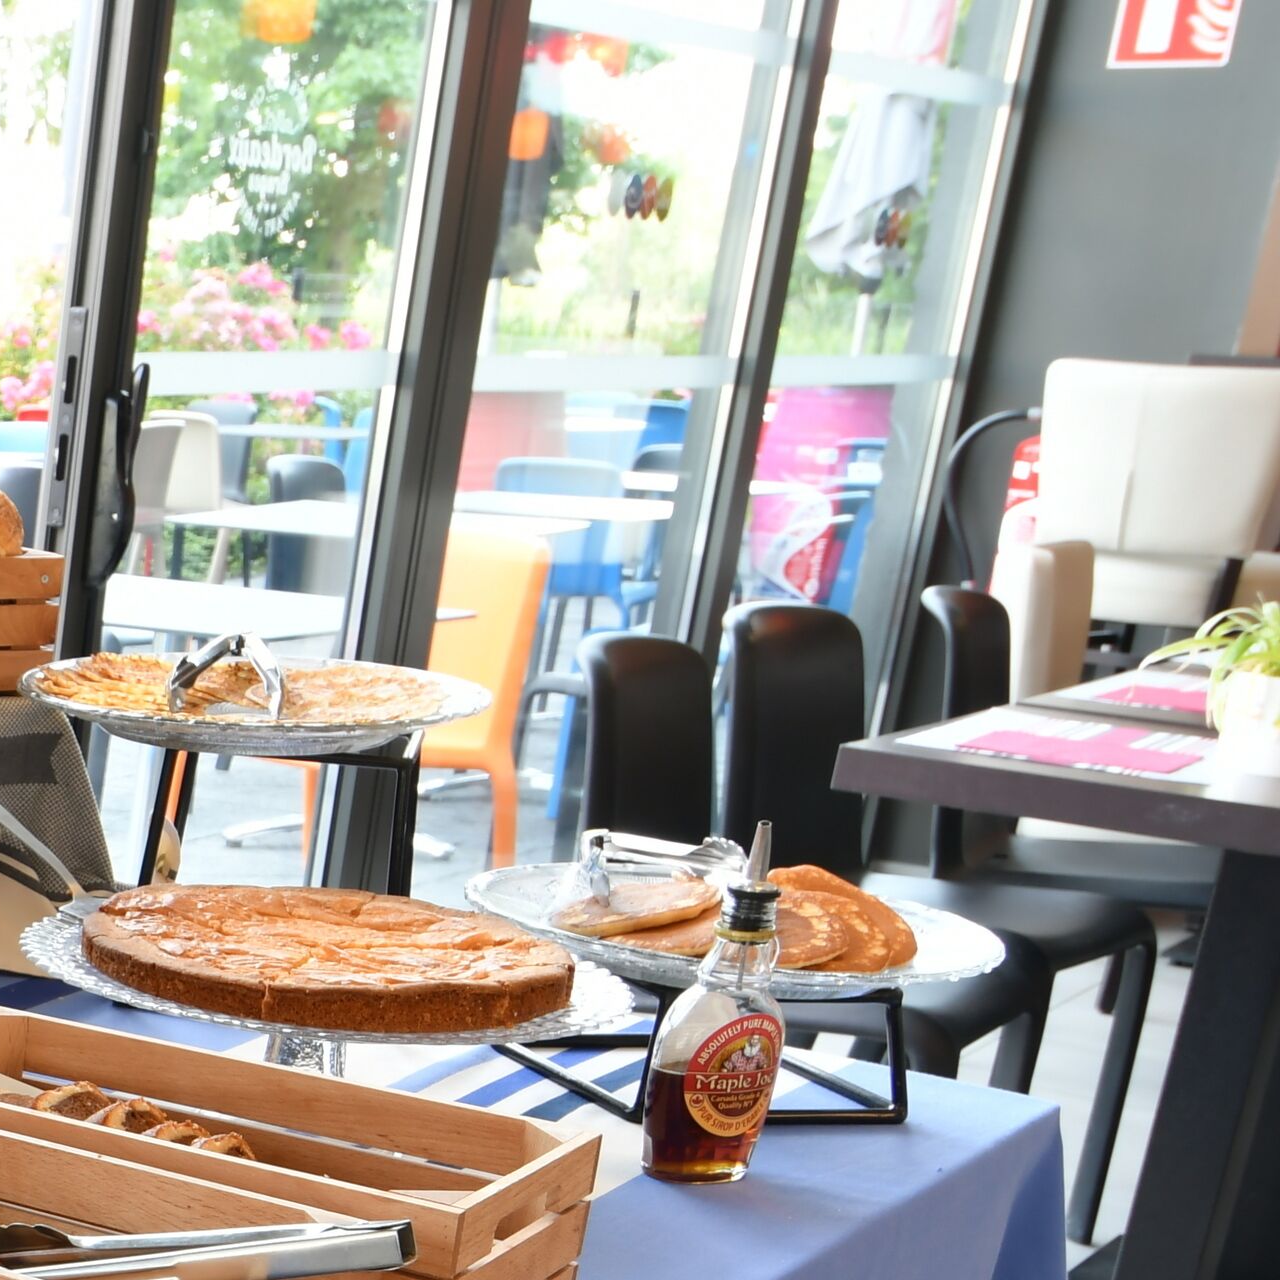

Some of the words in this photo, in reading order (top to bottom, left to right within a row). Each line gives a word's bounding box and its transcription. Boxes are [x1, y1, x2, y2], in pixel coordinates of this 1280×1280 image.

[698, 1023, 742, 1065] ABSOLUTELY
[743, 1019, 762, 1030] PURE
[696, 1074, 751, 1093] Maple
[755, 1073, 774, 1090] Joe
[698, 1106, 713, 1123] PUR
[711, 1117, 734, 1131] SIROP
